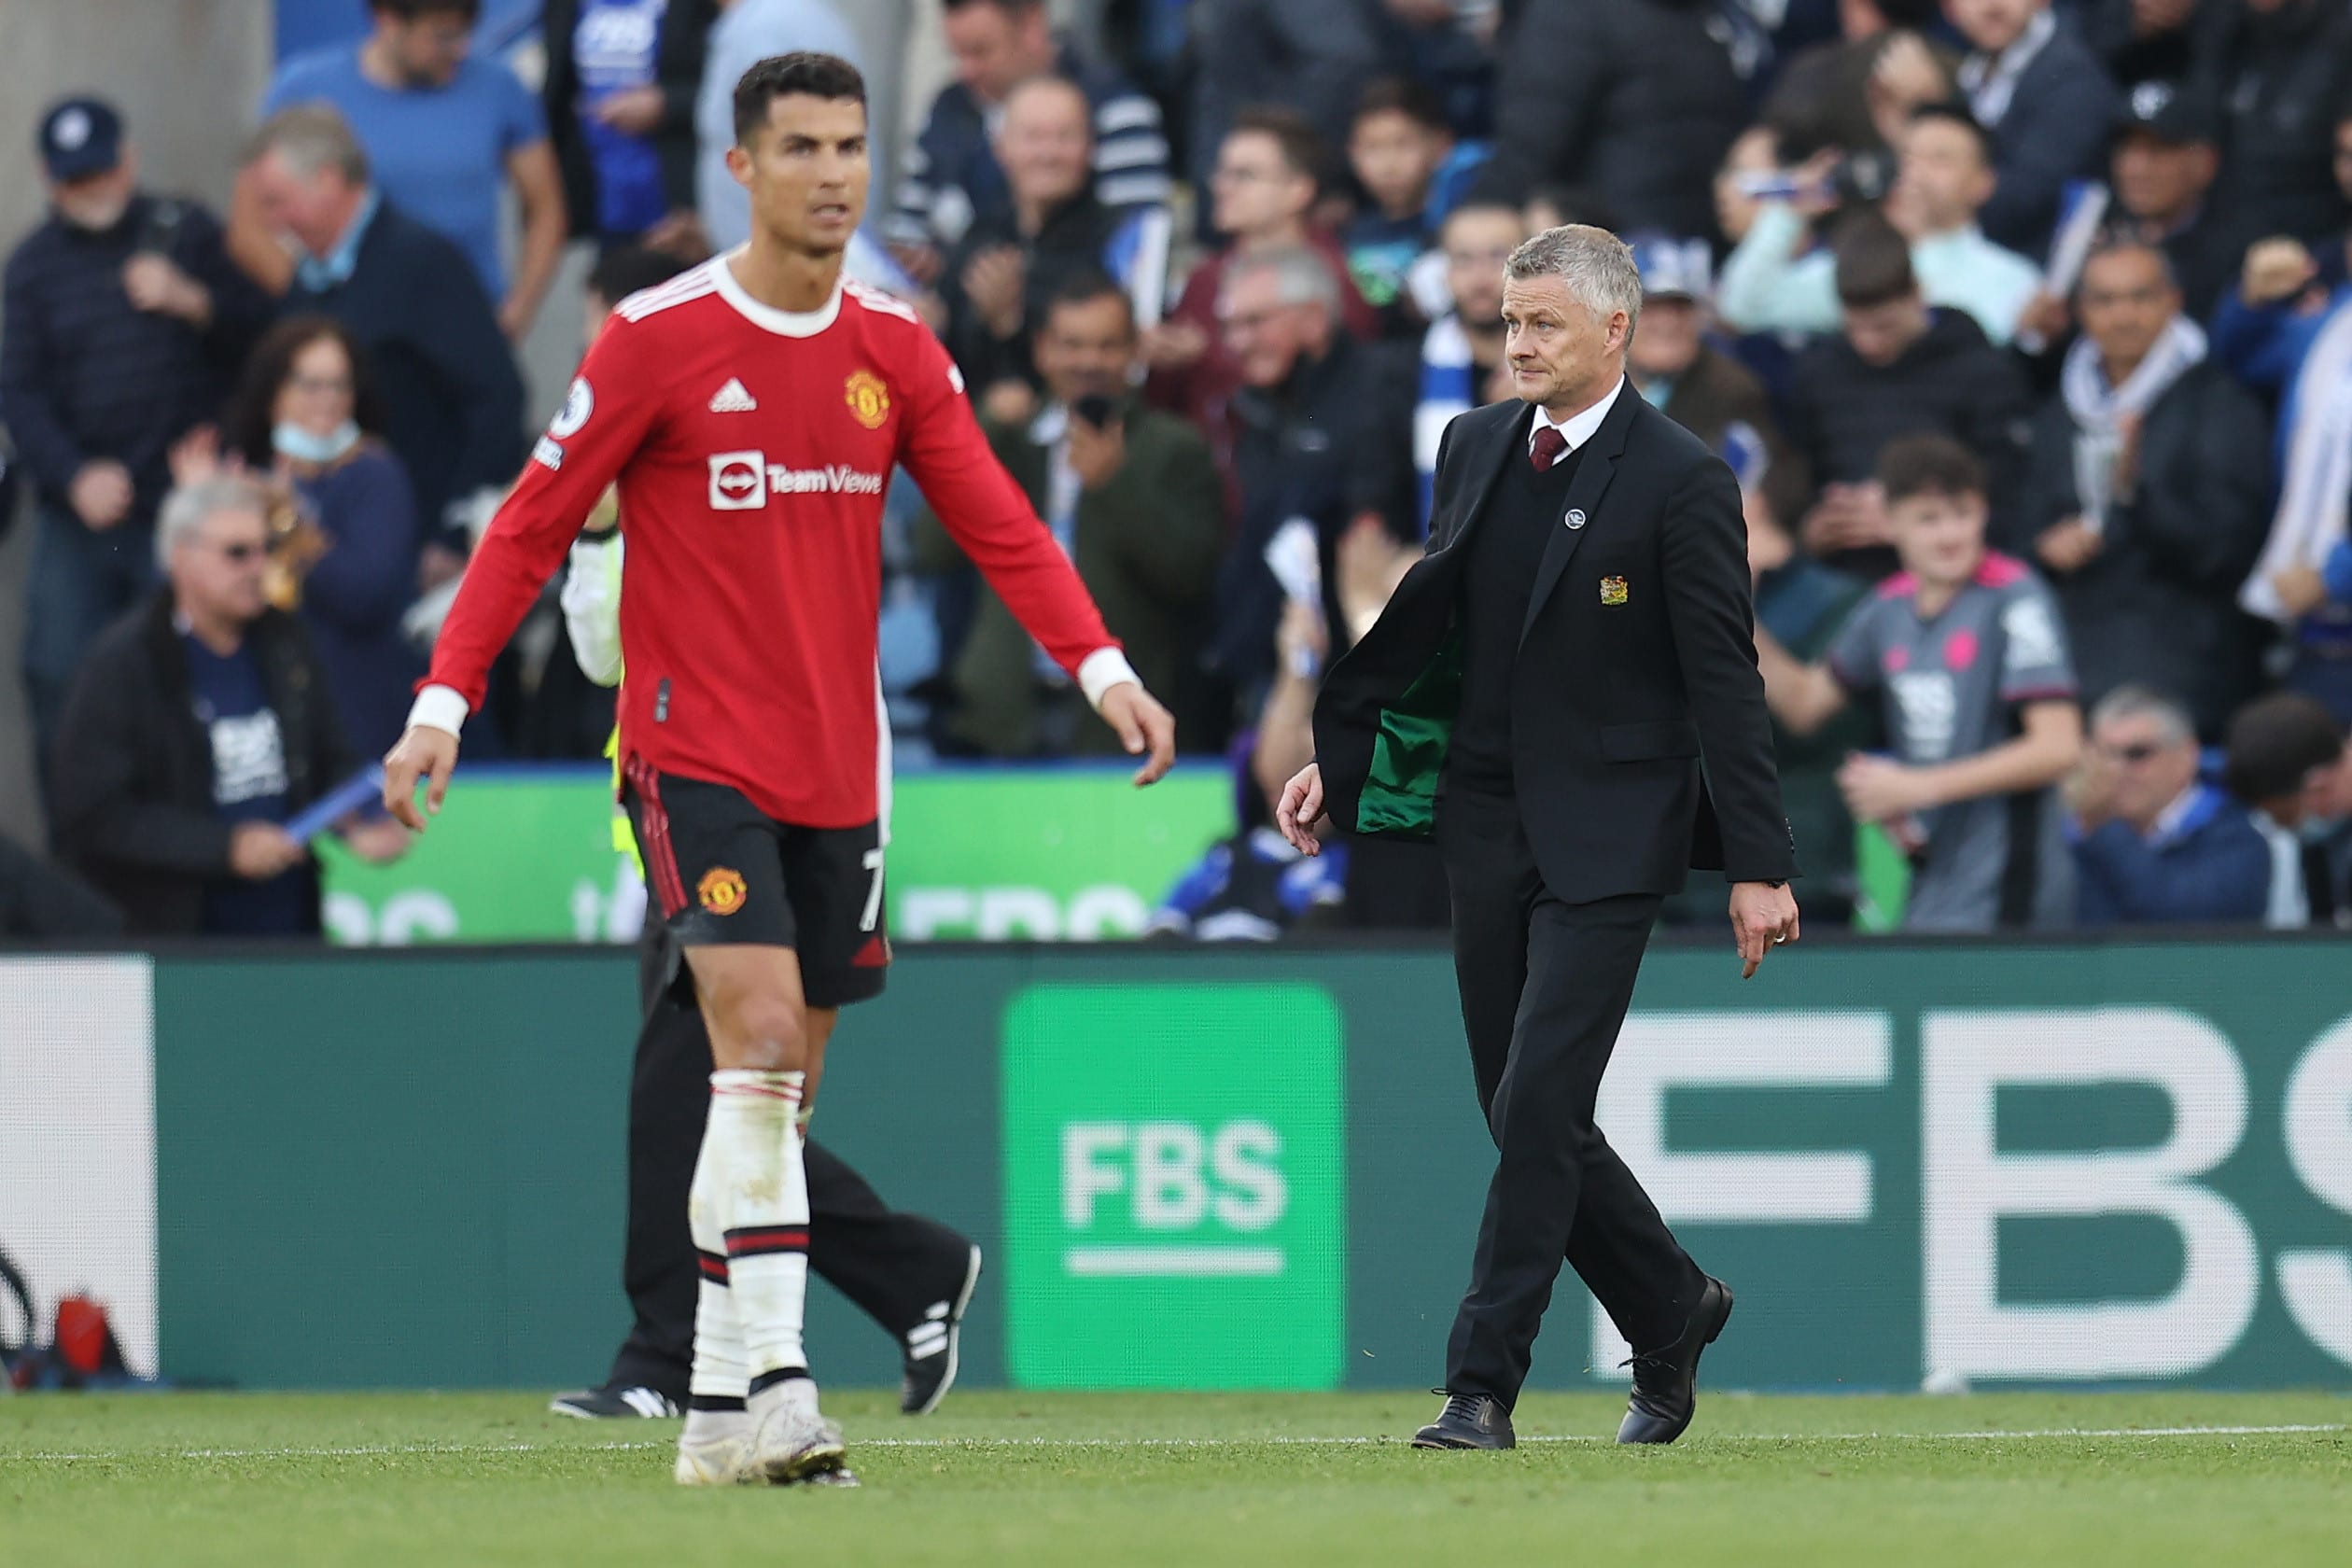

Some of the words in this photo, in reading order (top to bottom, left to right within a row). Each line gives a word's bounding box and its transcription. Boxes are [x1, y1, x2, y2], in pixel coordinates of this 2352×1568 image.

[860, 848, 885, 931] 7
[1062, 1119, 1287, 1231] FBS
[1590, 1005, 2352, 1381] FB
